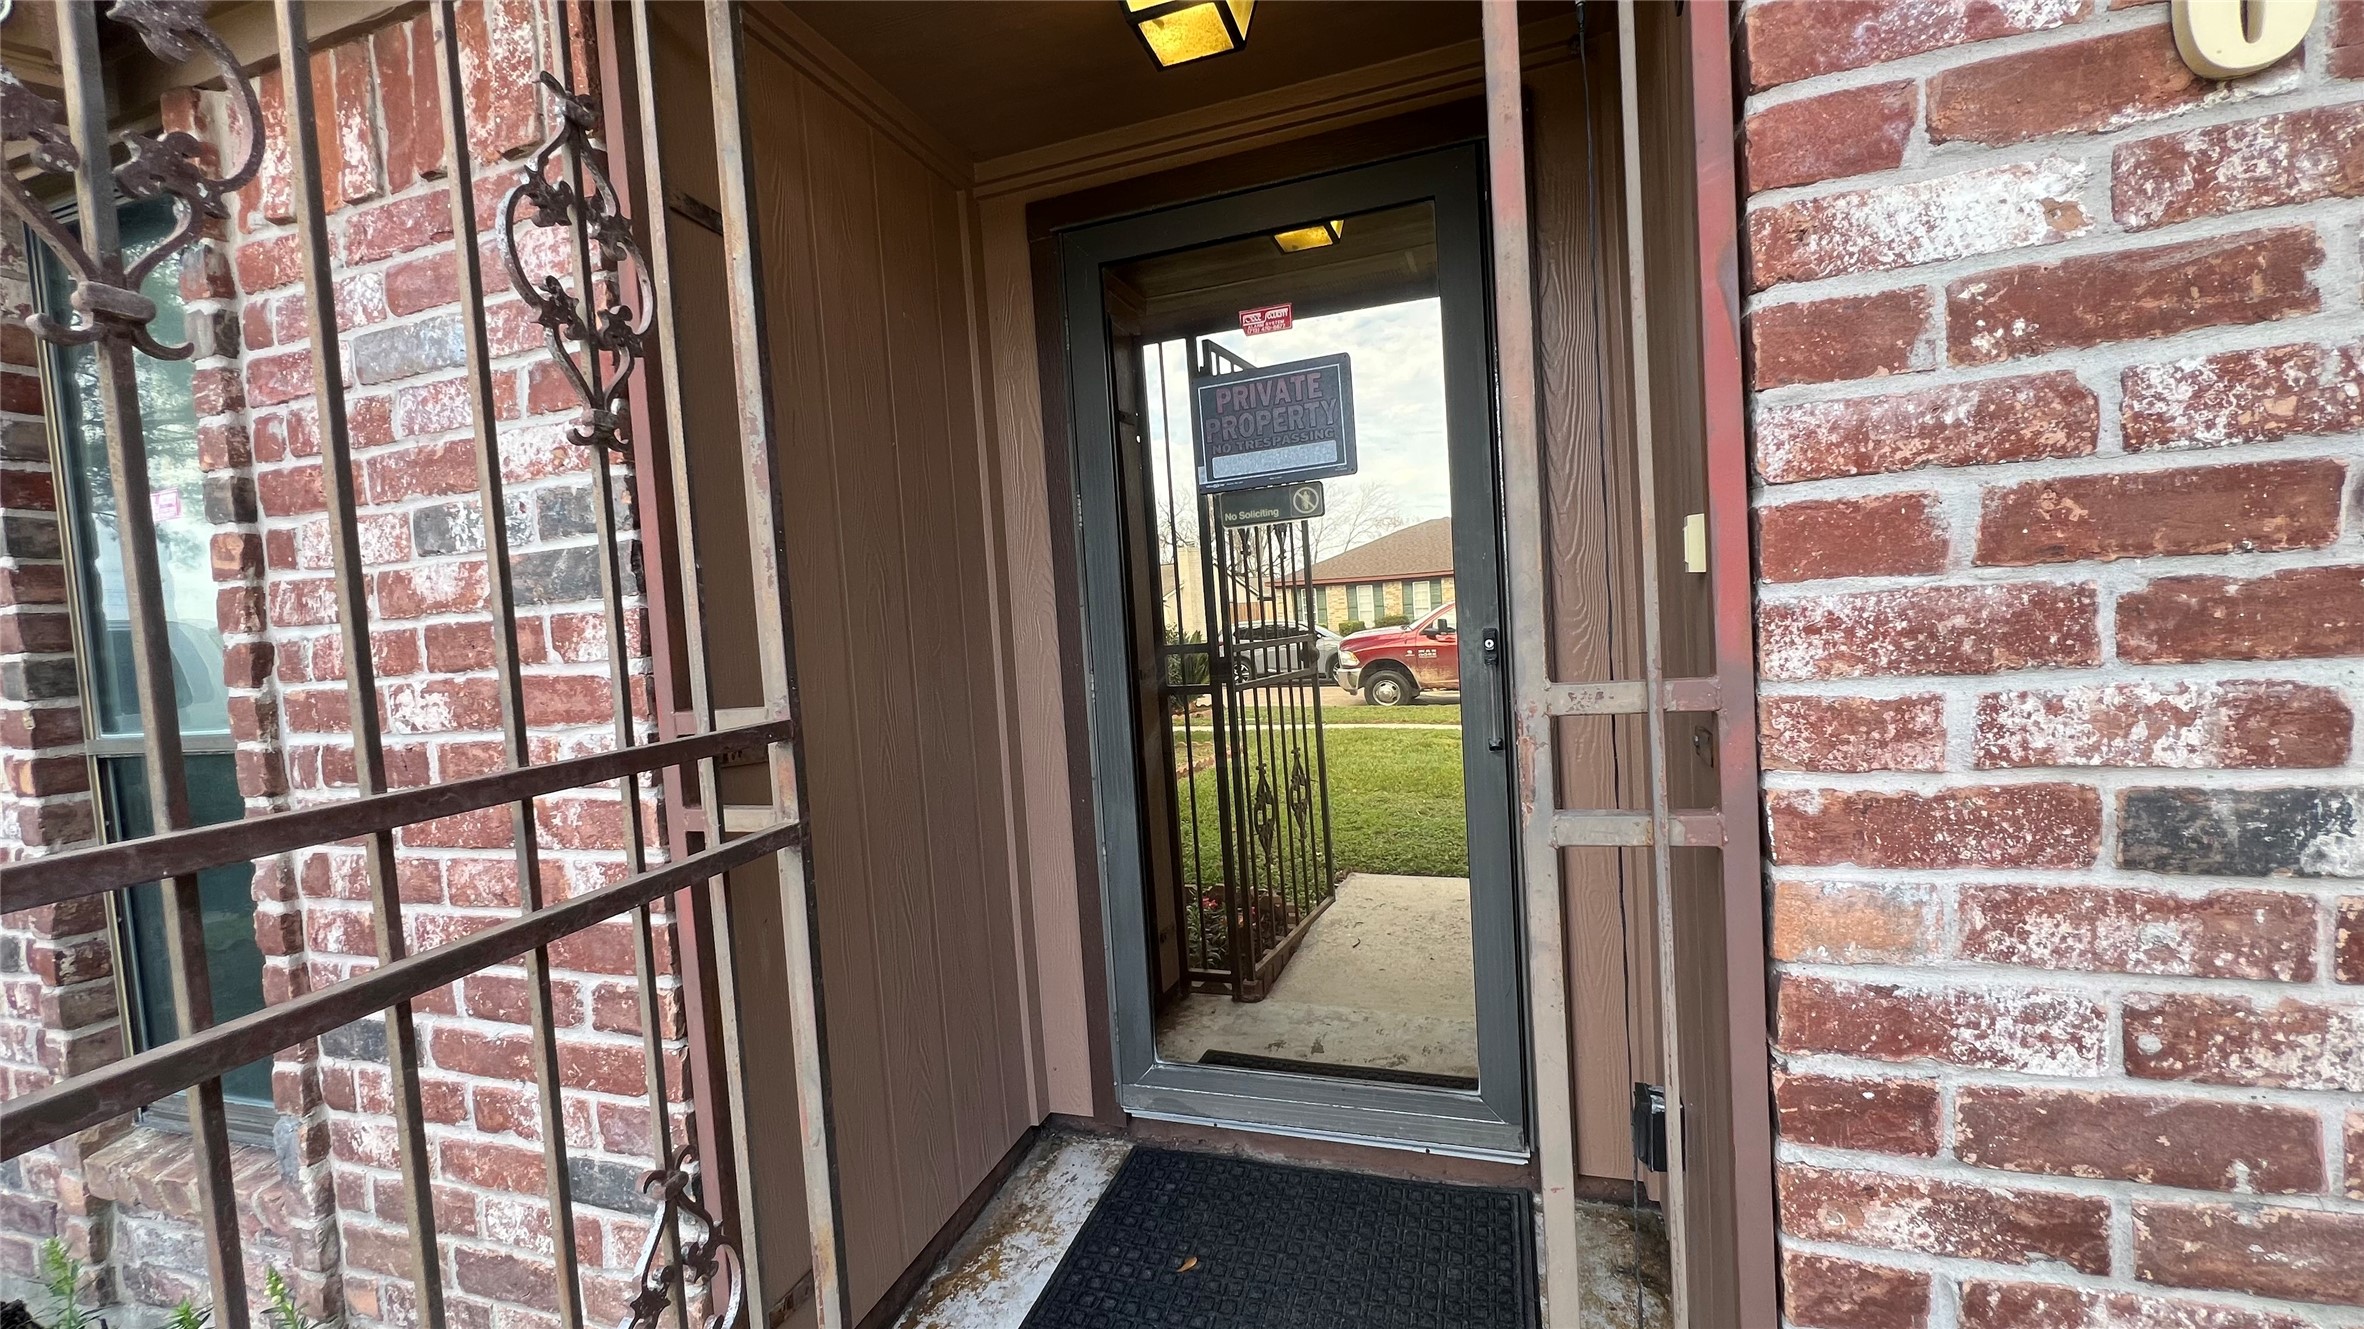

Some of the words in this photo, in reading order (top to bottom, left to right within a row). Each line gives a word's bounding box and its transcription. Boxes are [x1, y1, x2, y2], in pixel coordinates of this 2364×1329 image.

[1215, 372, 1323, 414] PRIVATE
[1205, 398, 1337, 444] PROPERTY
[1212, 442, 1231, 455] NO
[1236, 428, 1334, 452] TRESPASSING
[1225, 513, 1237, 521] No
[1239, 509, 1279, 520] Soliciting
